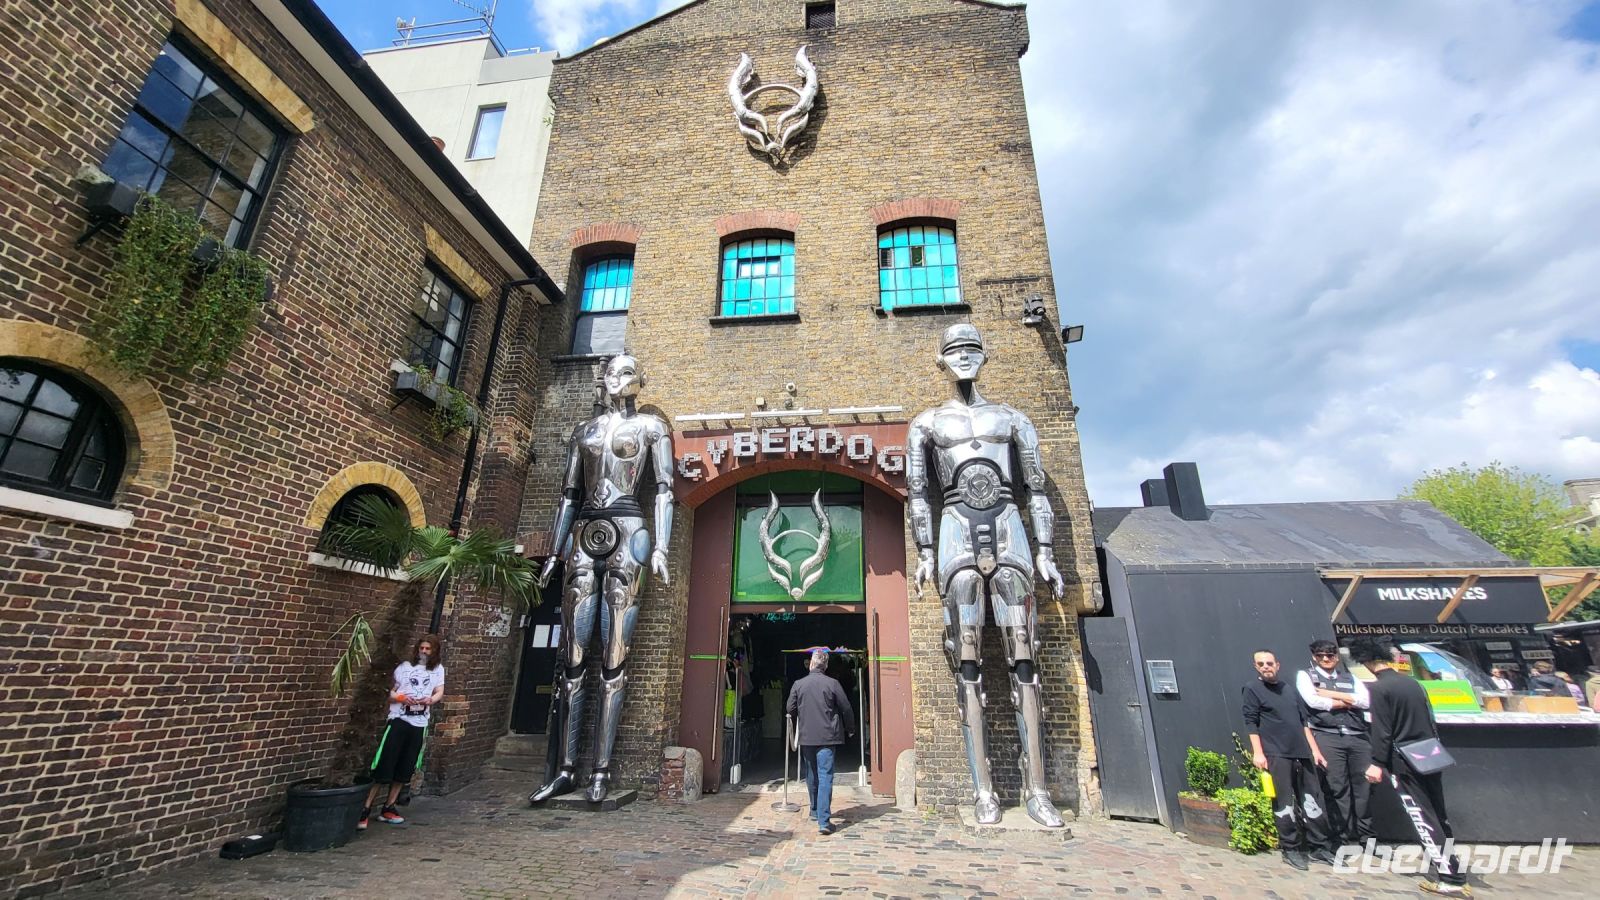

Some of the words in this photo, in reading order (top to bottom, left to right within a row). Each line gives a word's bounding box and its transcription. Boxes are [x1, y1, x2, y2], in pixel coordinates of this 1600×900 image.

[677, 426, 904, 479] CYBERDOG
[1336, 624, 1397, 634] Milkshake
[1399, 624, 1419, 634] Bar
[1429, 624, 1467, 634] Dutch
[1469, 624, 1529, 634] Pancakes
